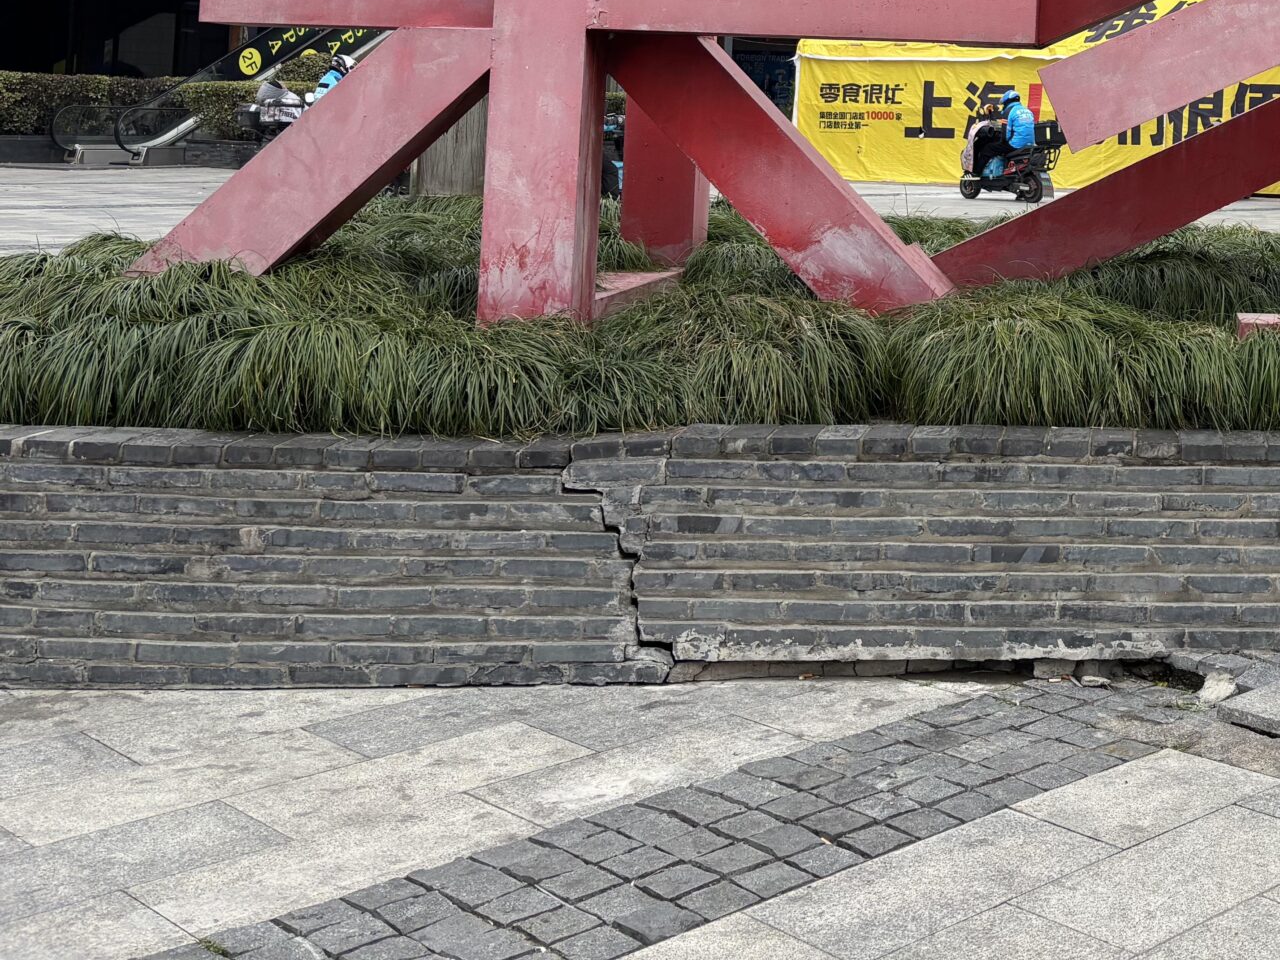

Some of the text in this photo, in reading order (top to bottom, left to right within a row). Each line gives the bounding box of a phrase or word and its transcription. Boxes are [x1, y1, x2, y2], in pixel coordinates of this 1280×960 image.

[241, 52, 258, 72] 2F
[820, 83, 905, 105] 零食很忙
